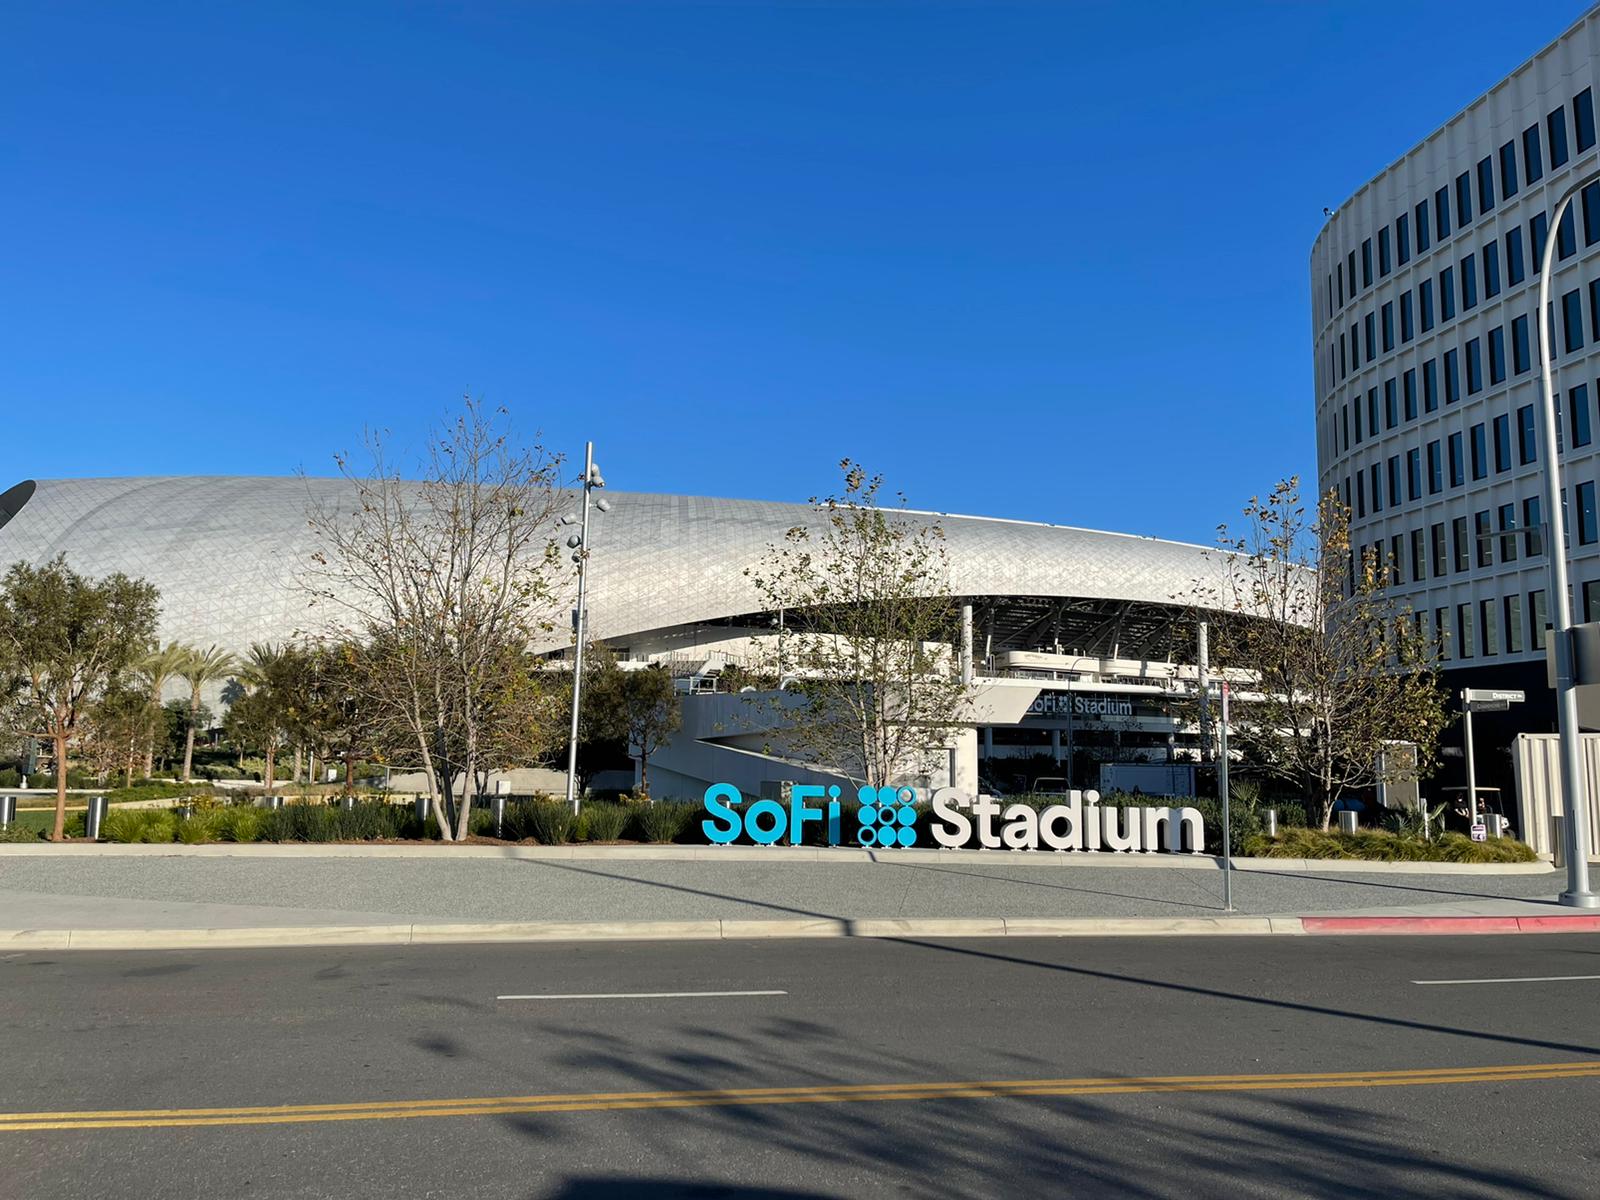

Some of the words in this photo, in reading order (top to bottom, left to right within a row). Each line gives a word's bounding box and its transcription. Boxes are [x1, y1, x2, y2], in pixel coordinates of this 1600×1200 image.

[1075, 696, 1133, 716] Stadium
[701, 783, 841, 846] SoFi
[931, 786, 1205, 853] Stadium
